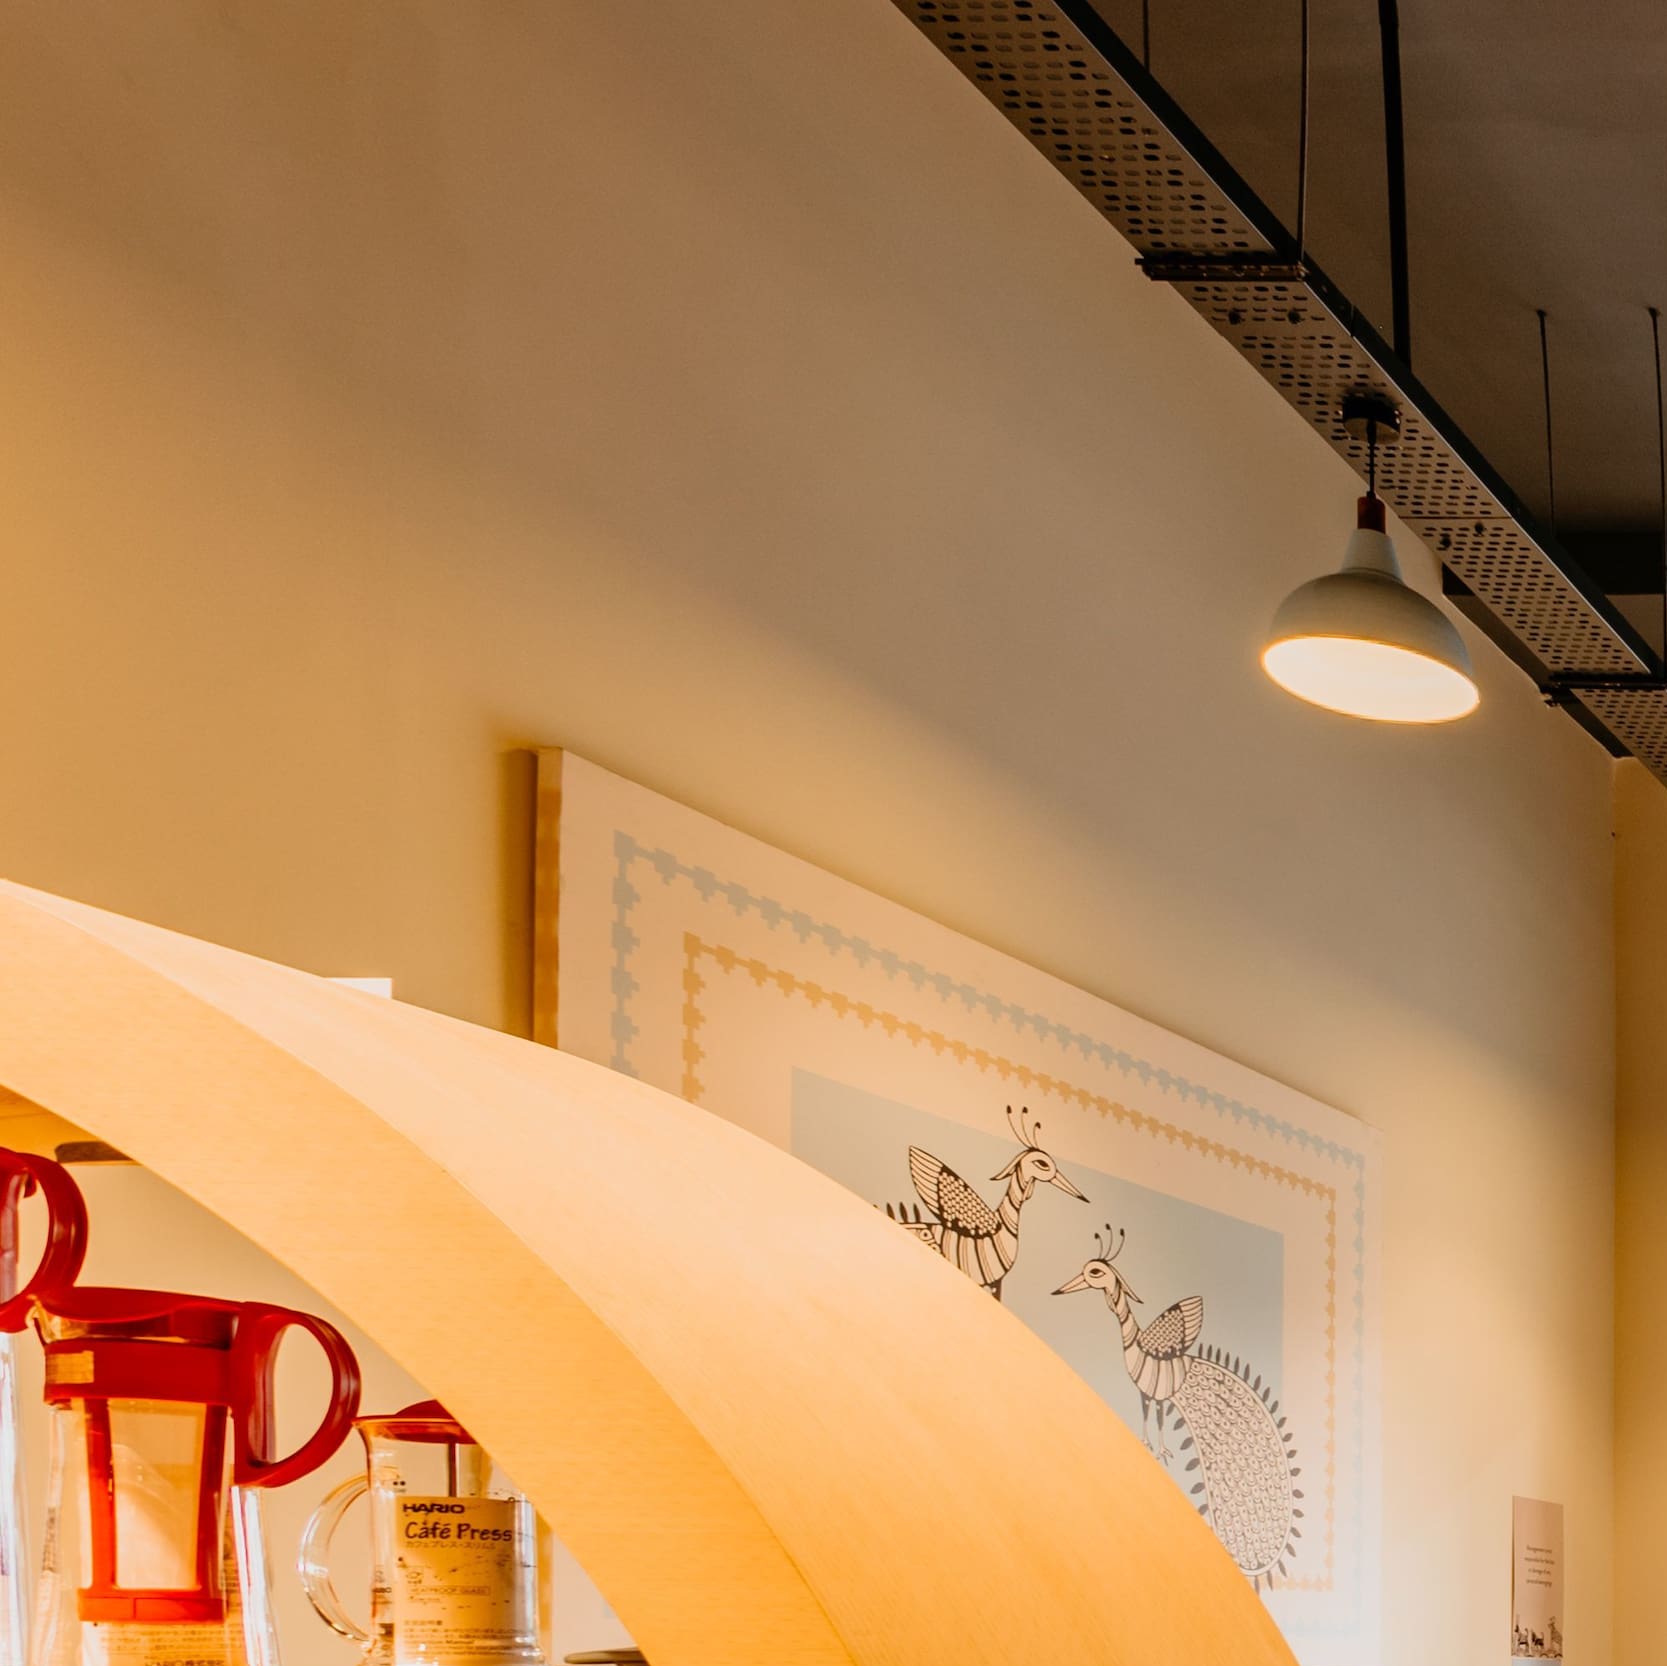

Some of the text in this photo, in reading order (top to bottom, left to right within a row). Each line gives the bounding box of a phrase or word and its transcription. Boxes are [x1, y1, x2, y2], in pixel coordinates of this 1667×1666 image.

[402, 1503, 465, 1514] HARIO
[405, 1521, 513, 1542] Café Press
